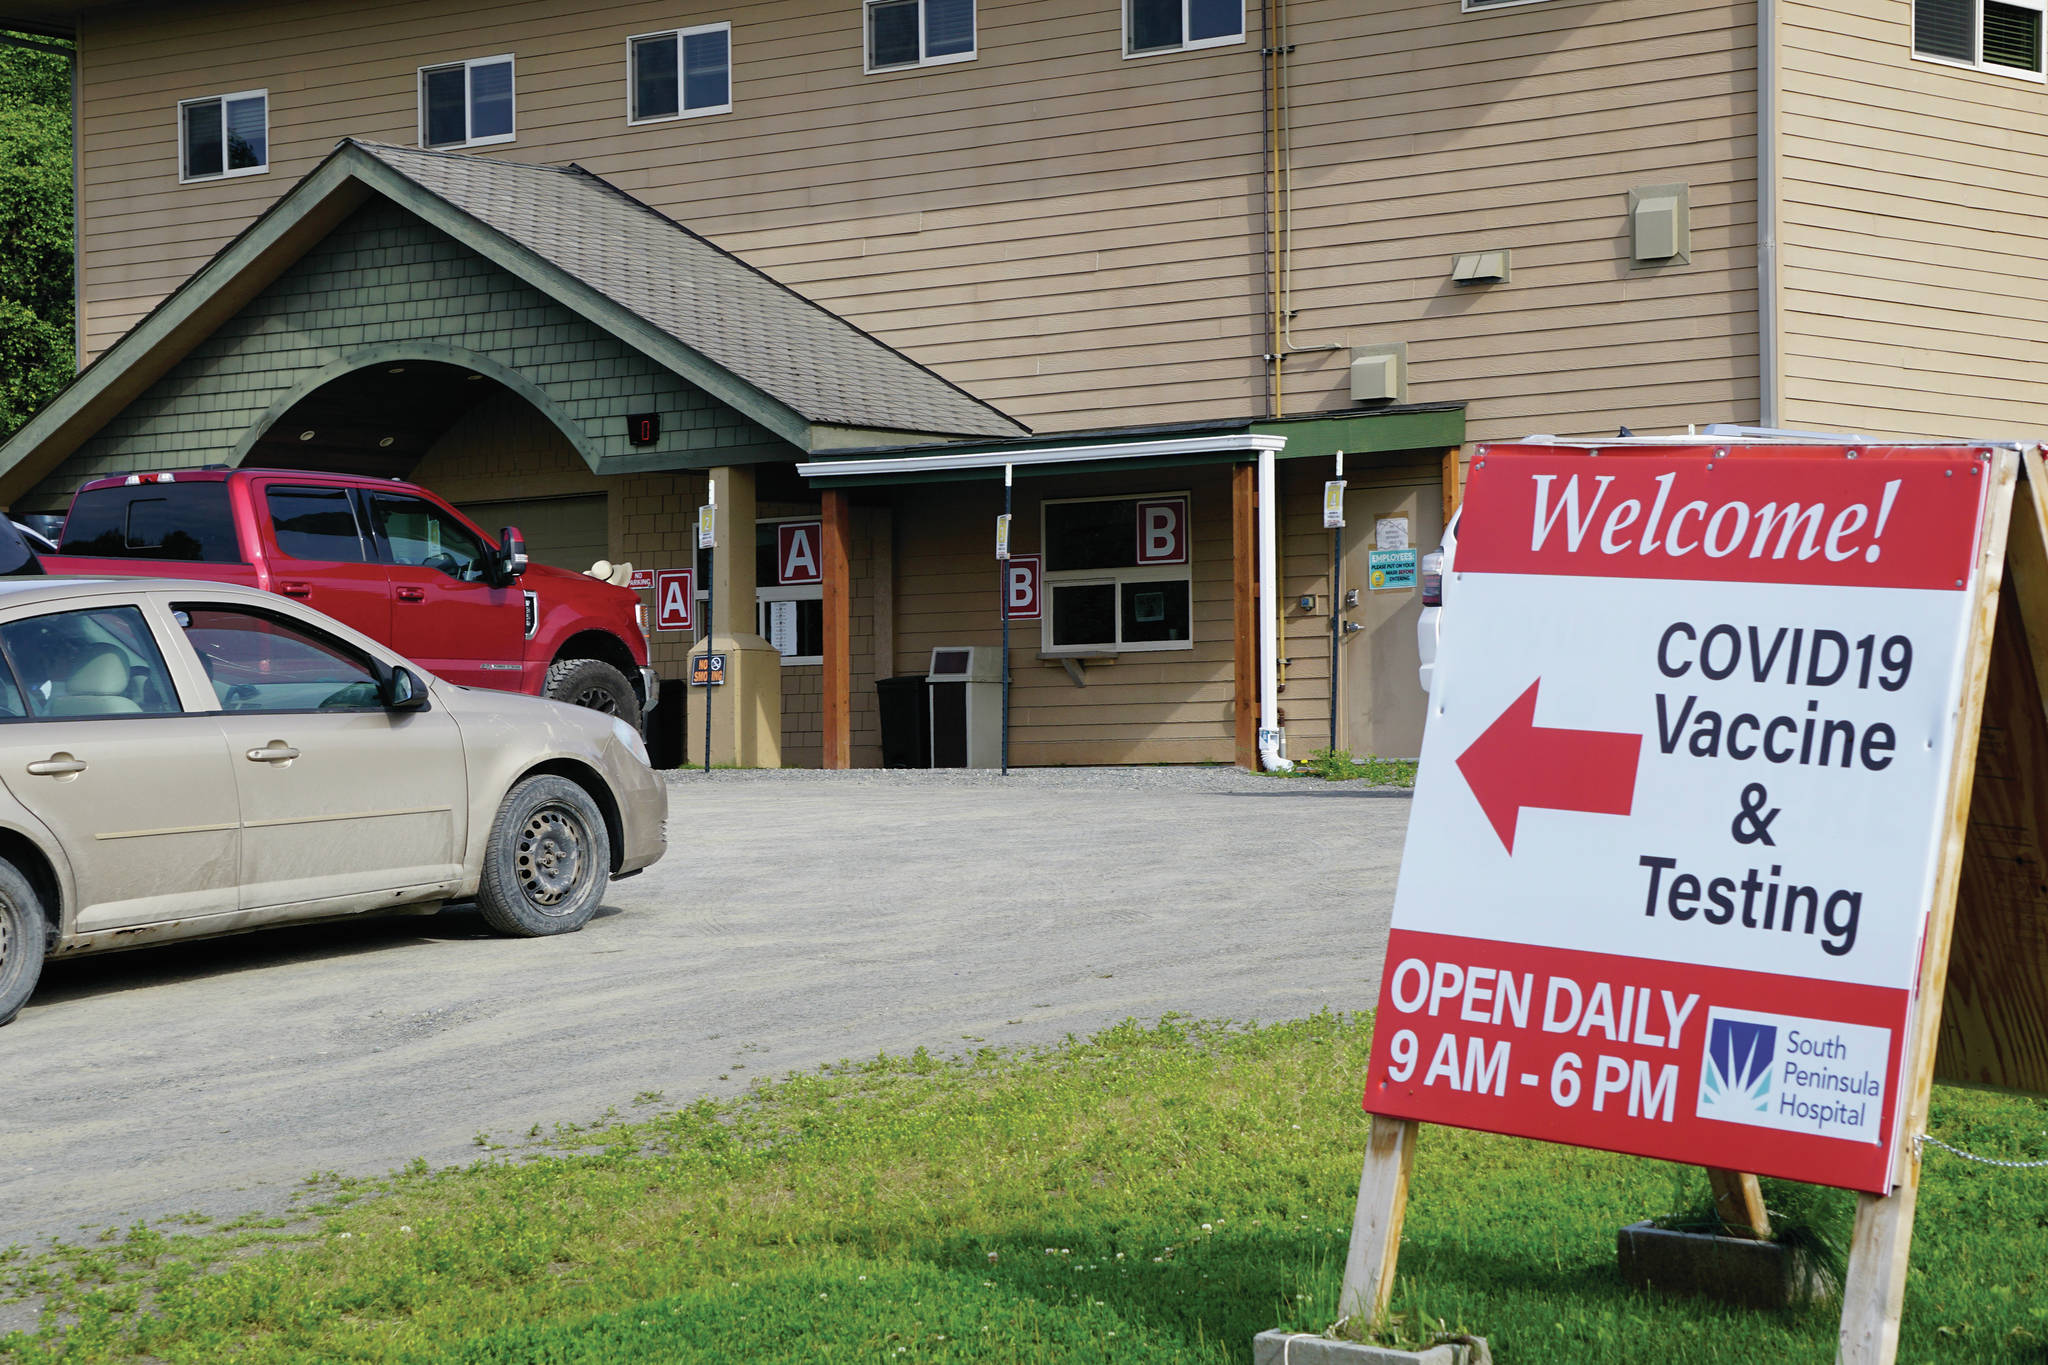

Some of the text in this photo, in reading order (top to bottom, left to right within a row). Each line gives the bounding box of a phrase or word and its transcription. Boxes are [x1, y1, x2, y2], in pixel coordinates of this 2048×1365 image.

[1145, 506, 1176, 557] B
[1531, 471, 1902, 563] Welcome!
[784, 529, 817, 578] A
[630, 578, 650, 586] ARKING
[662, 581, 687, 618] A
[1009, 567, 1033, 607] B
[693, 670, 723, 682] SMOING
[698, 659, 708, 670] NO
[1657, 621, 1913, 692] COVID19
[1655, 693, 1896, 771] Vaccine
[1731, 782, 1781, 847] &
[1638, 854, 1863, 956] Testing
[1391, 958, 1700, 1049] OPEN DAILY
[1786, 1030, 1846, 1060] South
[1388, 1029, 1419, 1082] 9
[1423, 1033, 1511, 1097] AM
[1550, 1051, 1583, 1108] 6
[1592, 1054, 1679, 1123] PM
[1783, 1061, 1880, 1097] Peninsula
[1780, 1091, 1866, 1129] Hospital
